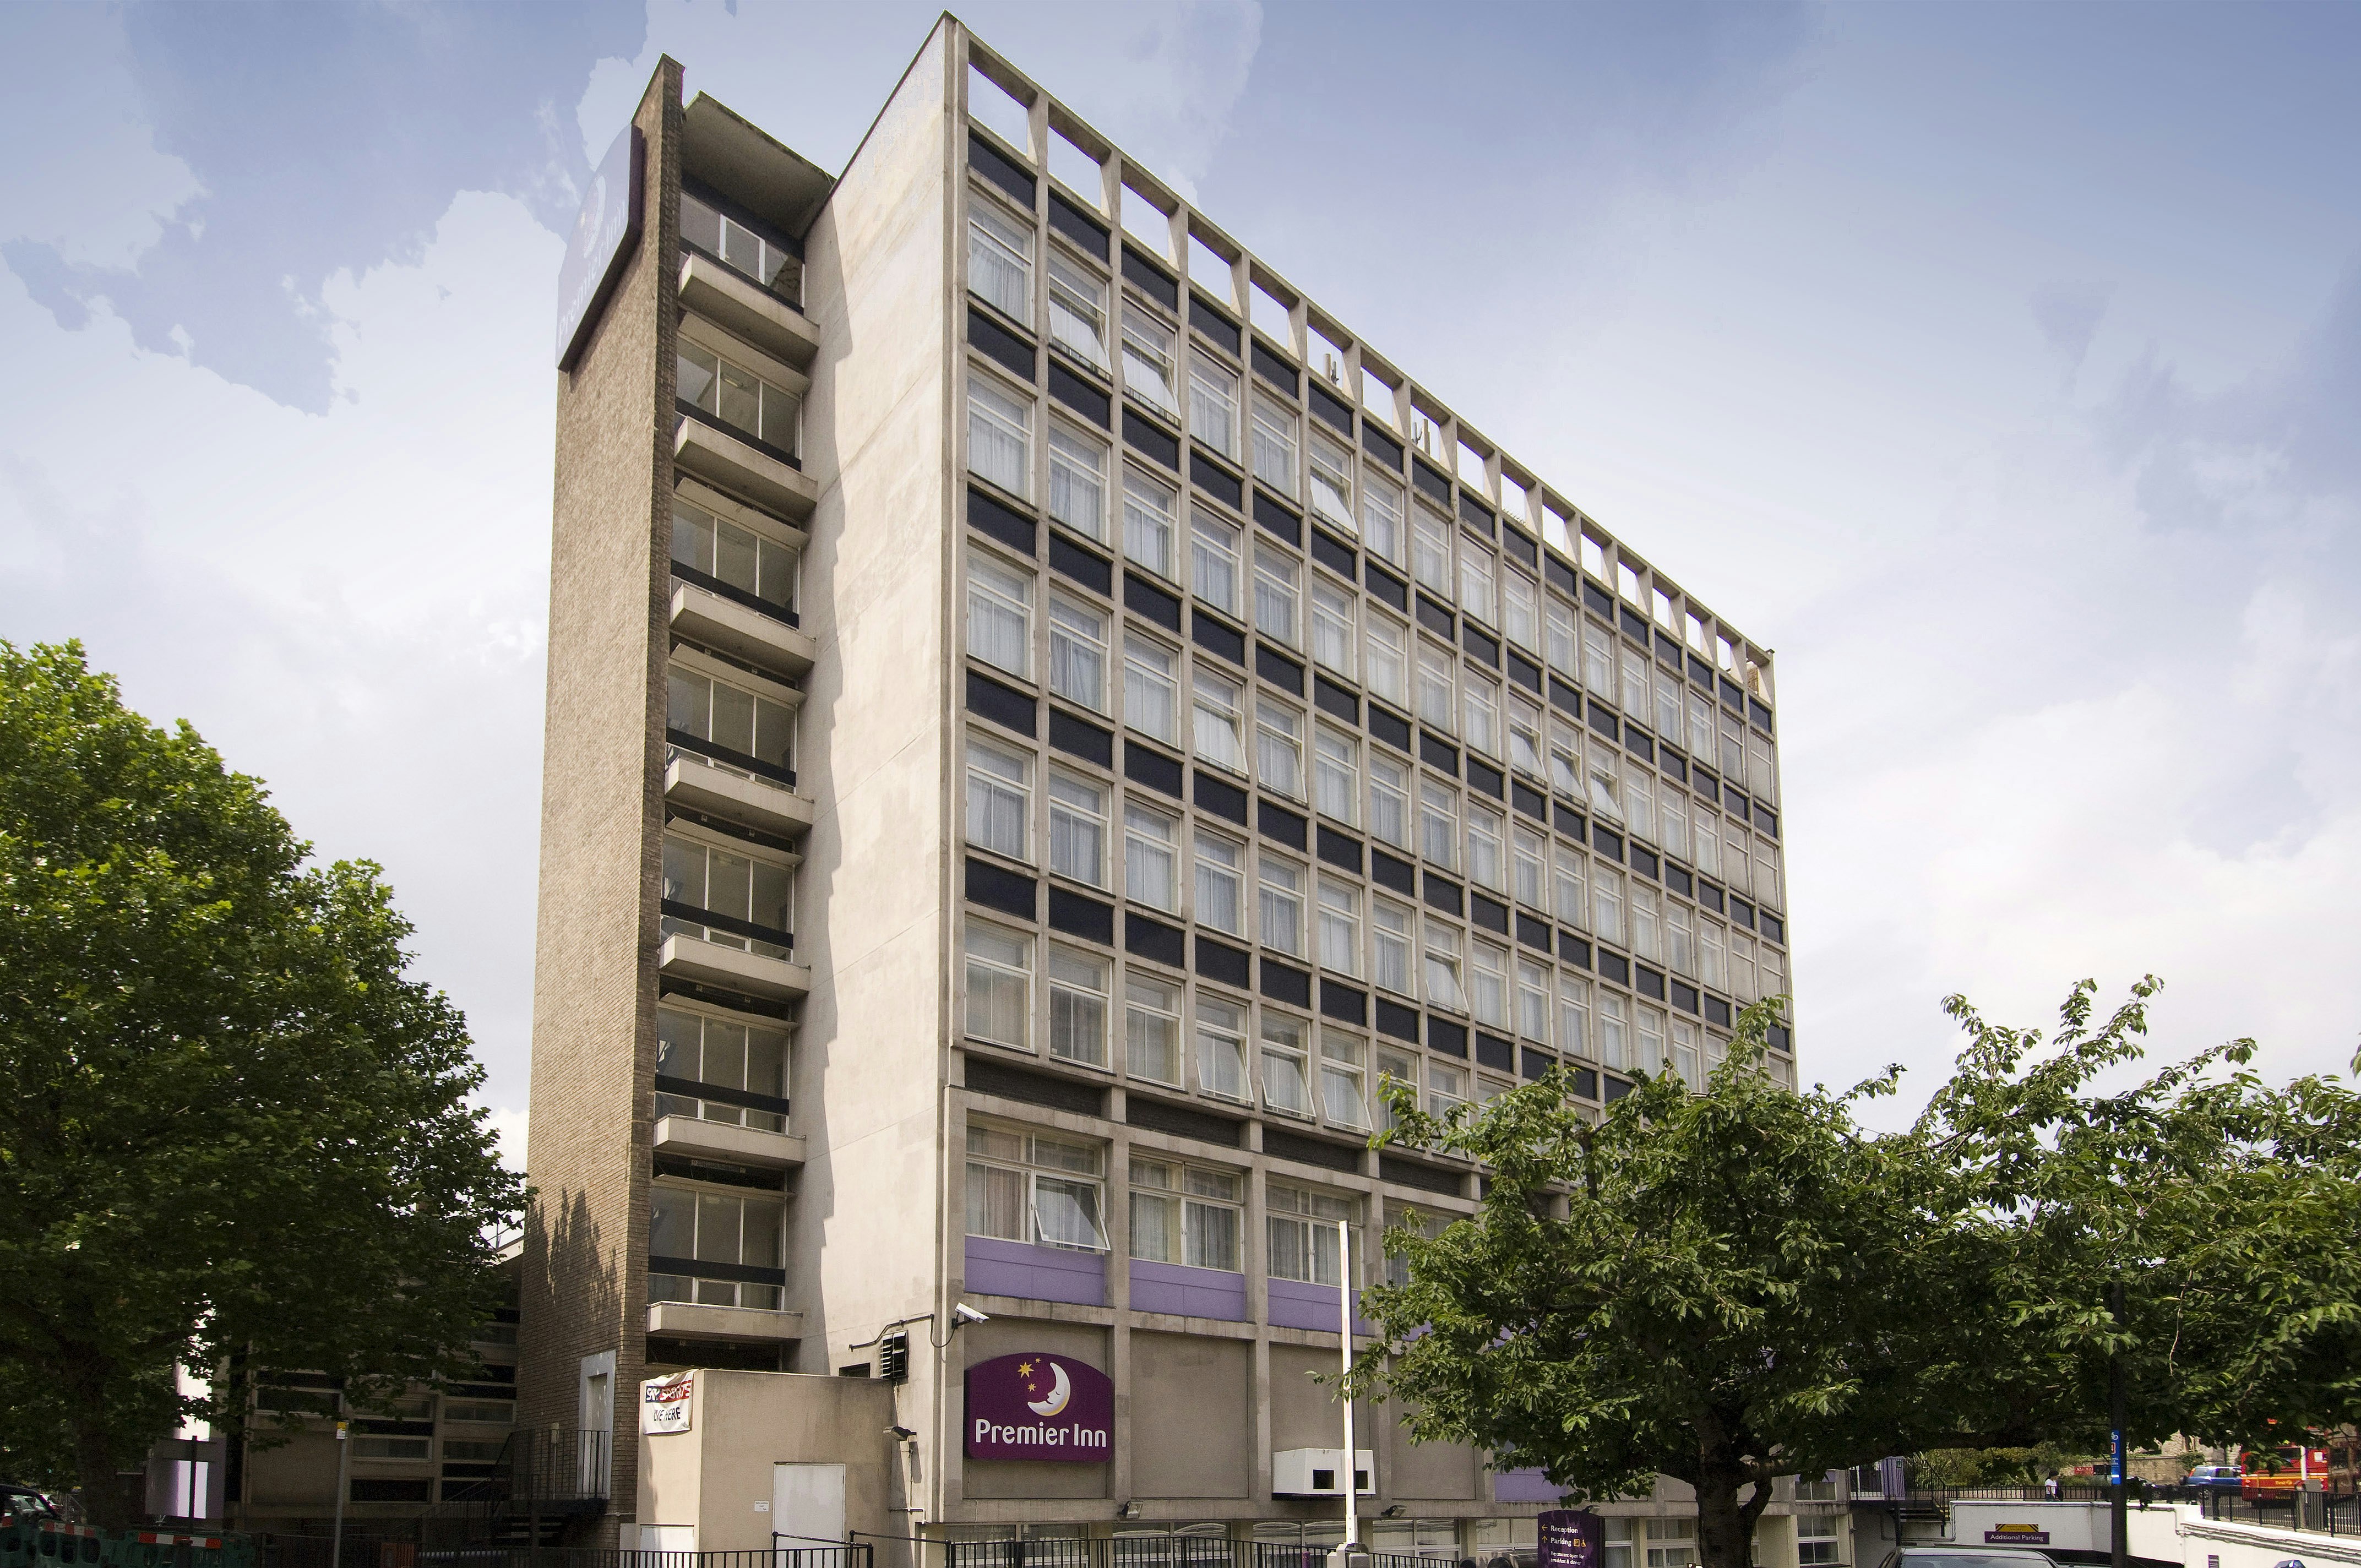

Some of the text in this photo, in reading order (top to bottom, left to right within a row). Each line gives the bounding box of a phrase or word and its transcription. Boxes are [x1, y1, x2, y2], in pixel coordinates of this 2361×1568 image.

[663, 1407, 681, 1420] HERE
[976, 1419, 1106, 1447] Premier Inn
[1551, 1525, 1579, 1534] Reception
[1551, 1537, 1571, 1547] Parking
